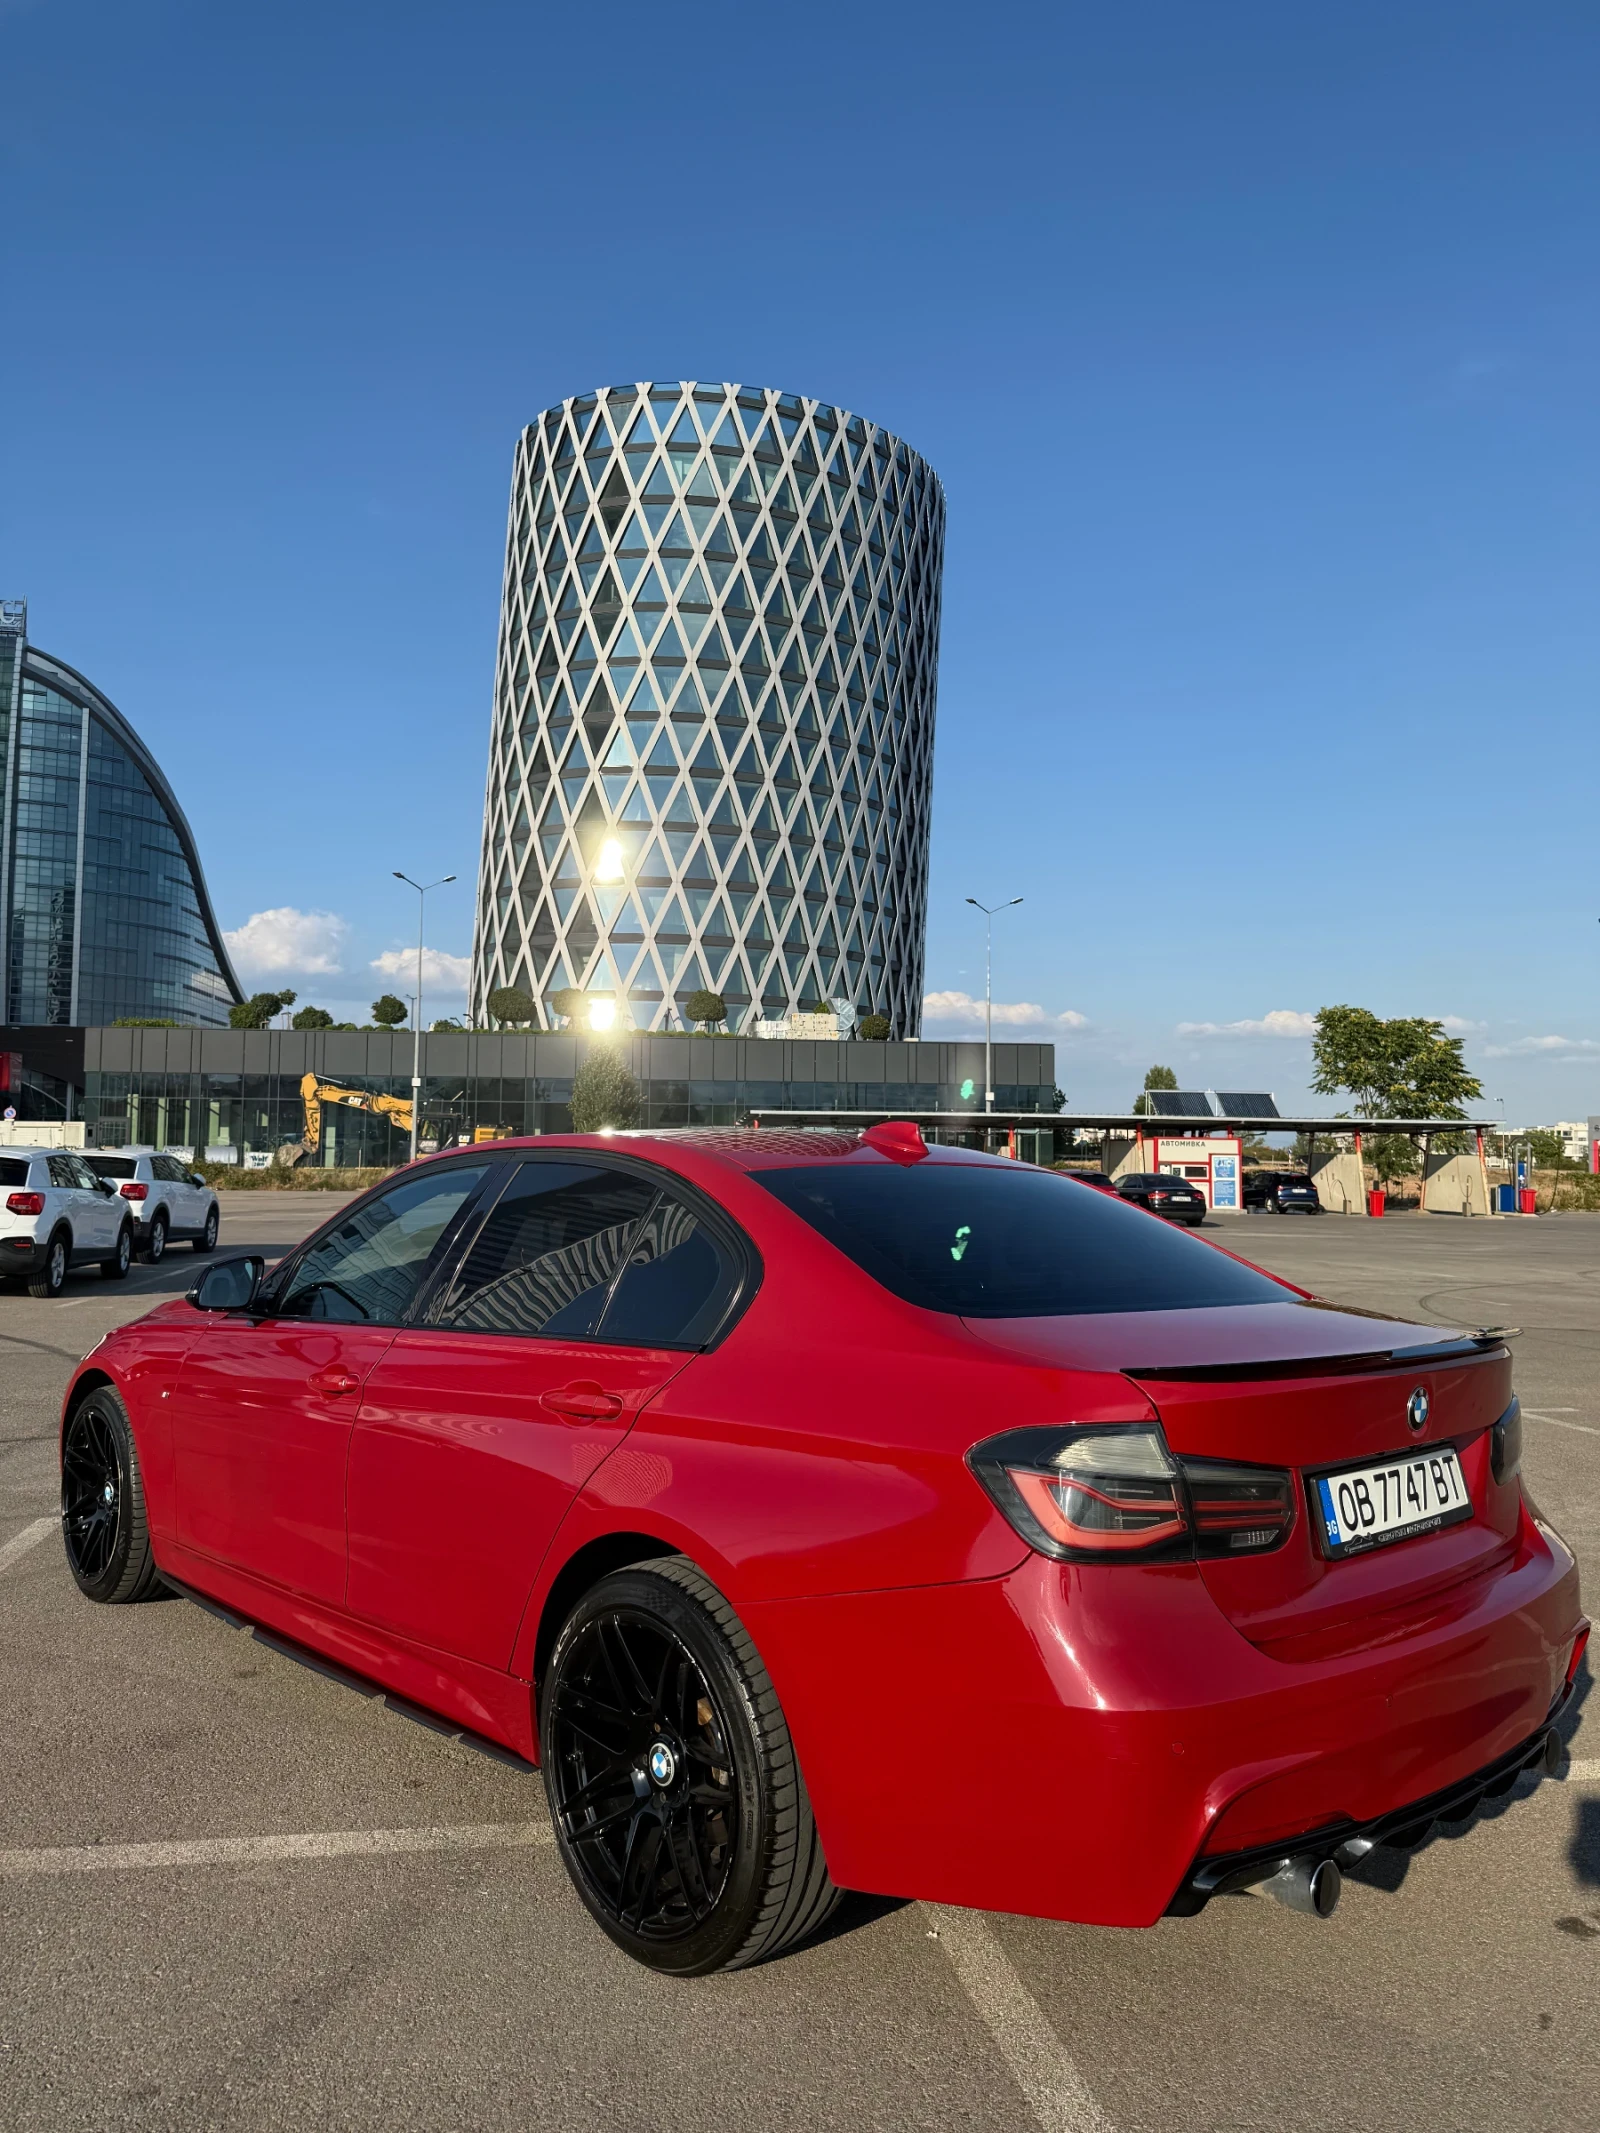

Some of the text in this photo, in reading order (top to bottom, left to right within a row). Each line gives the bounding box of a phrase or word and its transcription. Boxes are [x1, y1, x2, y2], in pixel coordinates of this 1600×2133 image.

[348, 1096, 363, 1107] CAT
[458, 1135, 470, 1143] CAT
[1161, 1140, 1206, 1148] АВТОМИВКА
[1338, 1478, 1375, 1531] OB
[1373, 1463, 1427, 1523] 7747
[1429, 1455, 1460, 1505] BT
